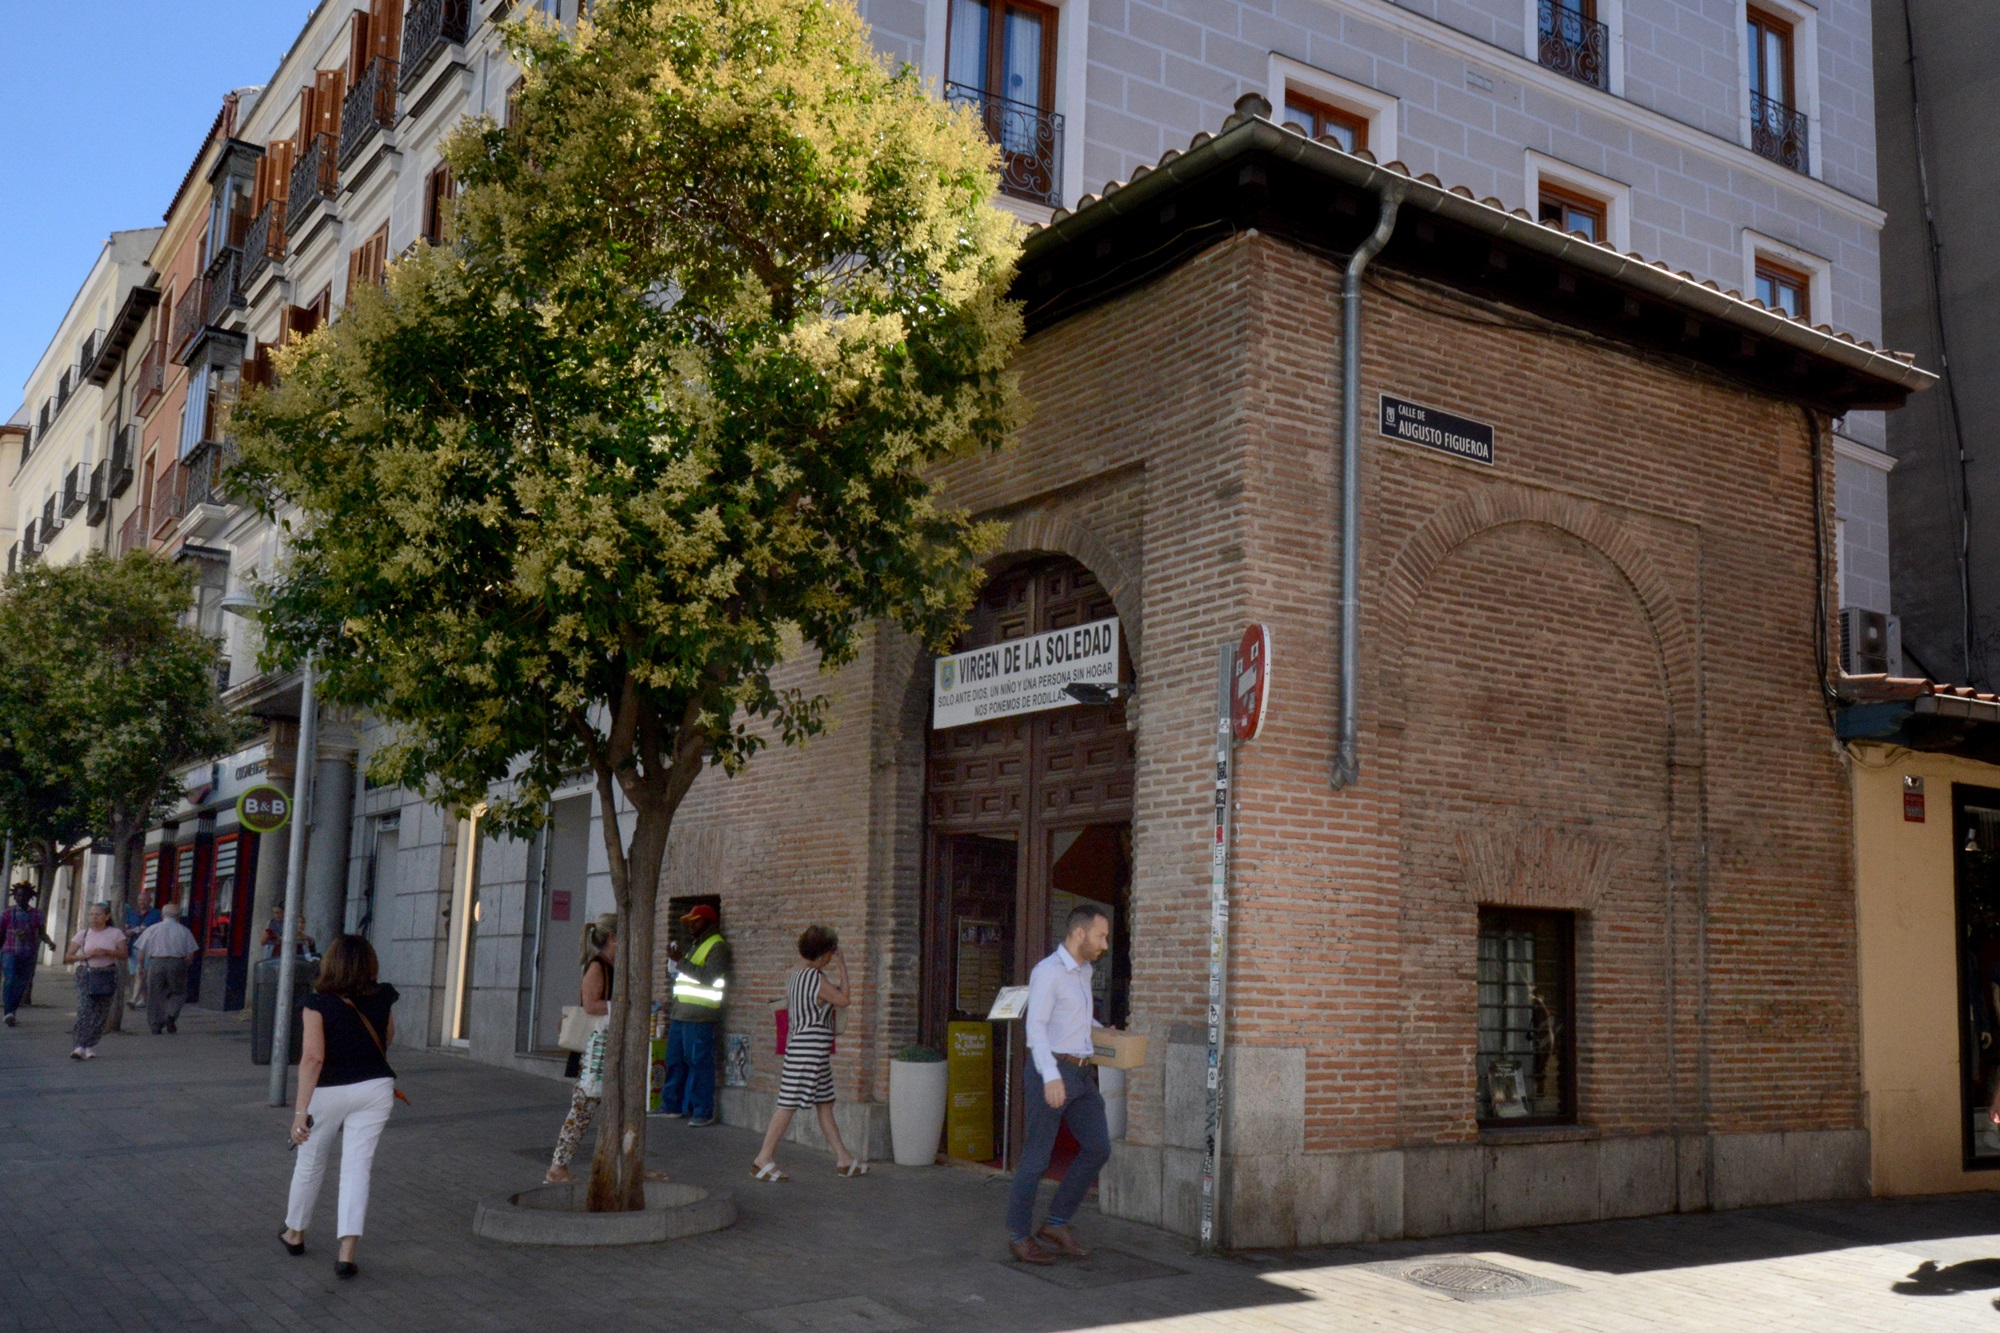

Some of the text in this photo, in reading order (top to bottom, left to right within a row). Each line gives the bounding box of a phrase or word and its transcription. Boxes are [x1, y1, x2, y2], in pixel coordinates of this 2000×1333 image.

[1398, 404, 1426, 421] CALLE DE
[1398, 420, 1489, 458] AUGUSTO FIGUEROA
[959, 624, 1112, 684] VIRGEN DE LA SOLEDAD
[938, 694, 954, 708] SOLO
[955, 690, 971, 704] ANTE
[990, 685, 999, 698] UN
[1000, 679, 1017, 696] NIÑO
[1017, 680, 1022, 692] Y
[1023, 678, 1037, 691] UNA
[1038, 670, 1071, 688] PERSONA
[1073, 667, 1085, 681] SIN
[1086, 662, 1113, 679] HOGAR
[974, 689, 1067, 716] NOS PONEMOS DE RODILLAS
